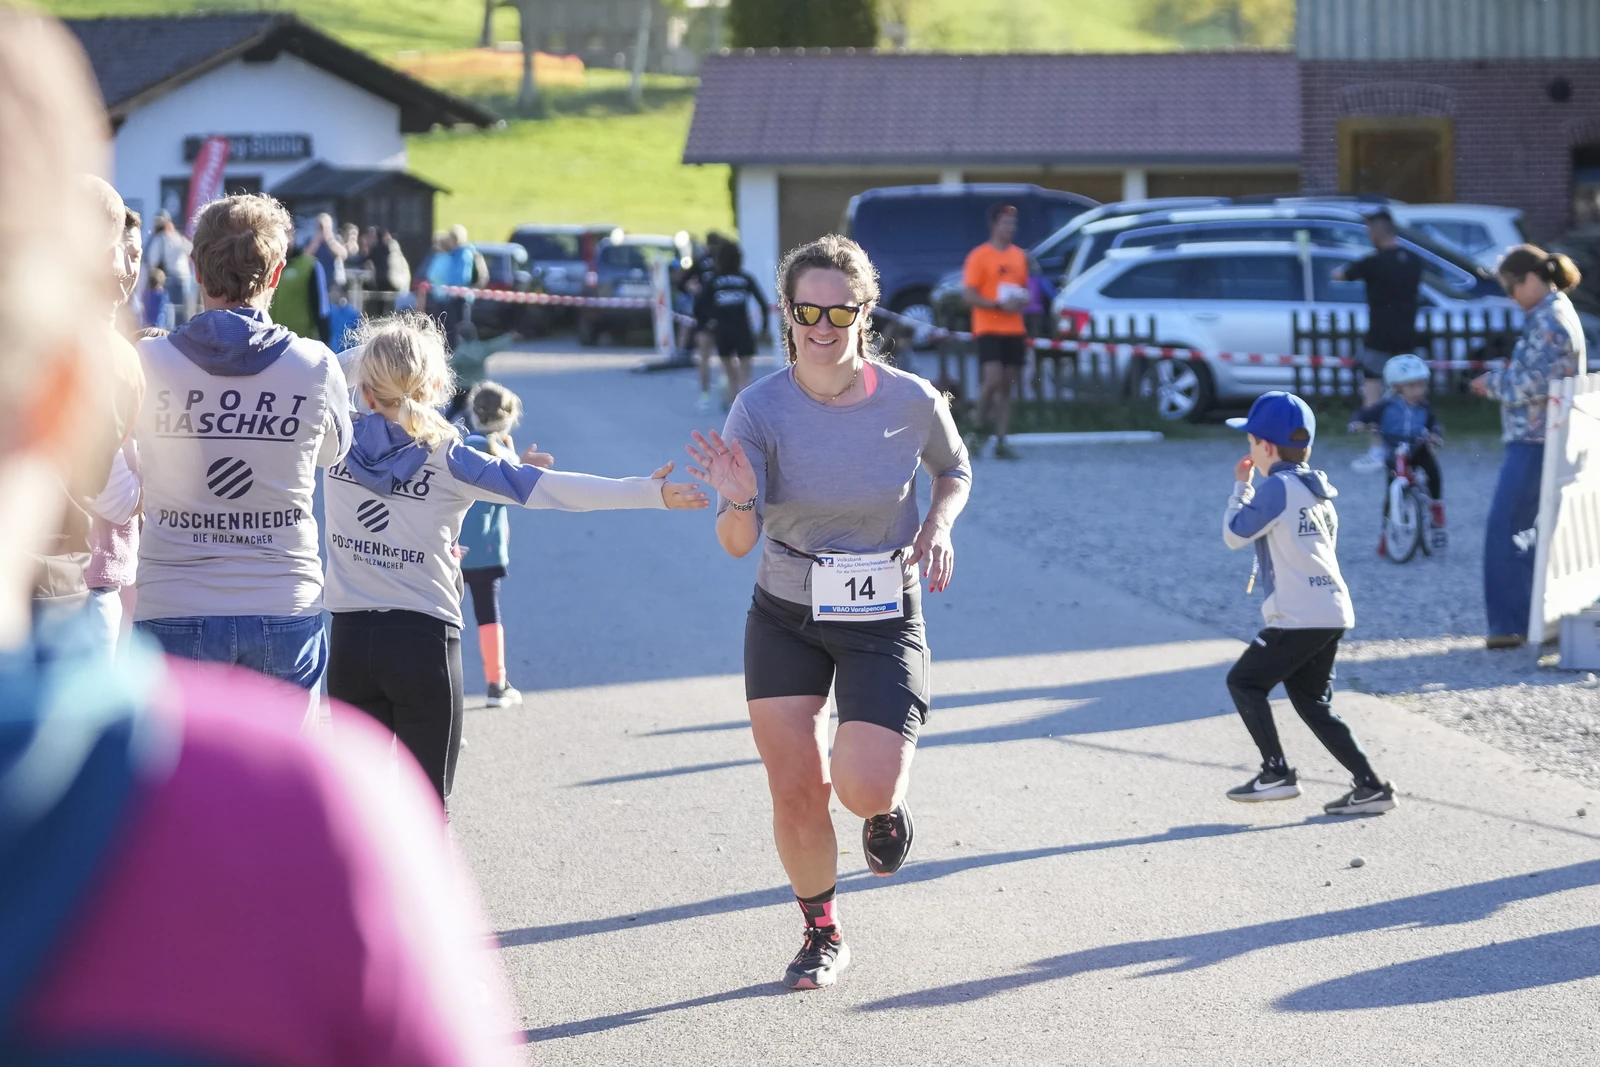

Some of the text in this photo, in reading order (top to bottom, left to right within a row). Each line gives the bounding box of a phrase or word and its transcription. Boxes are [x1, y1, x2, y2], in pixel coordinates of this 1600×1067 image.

[156, 390, 307, 415] SPORT
[155, 413, 300, 437] HASCHKO
[159, 508, 303, 530] POSCHENRIEDER
[193, 534, 273, 545] DIE HOLZMACHER
[845, 575, 876, 601] 14
[850, 605, 887, 613] Voralpencup
